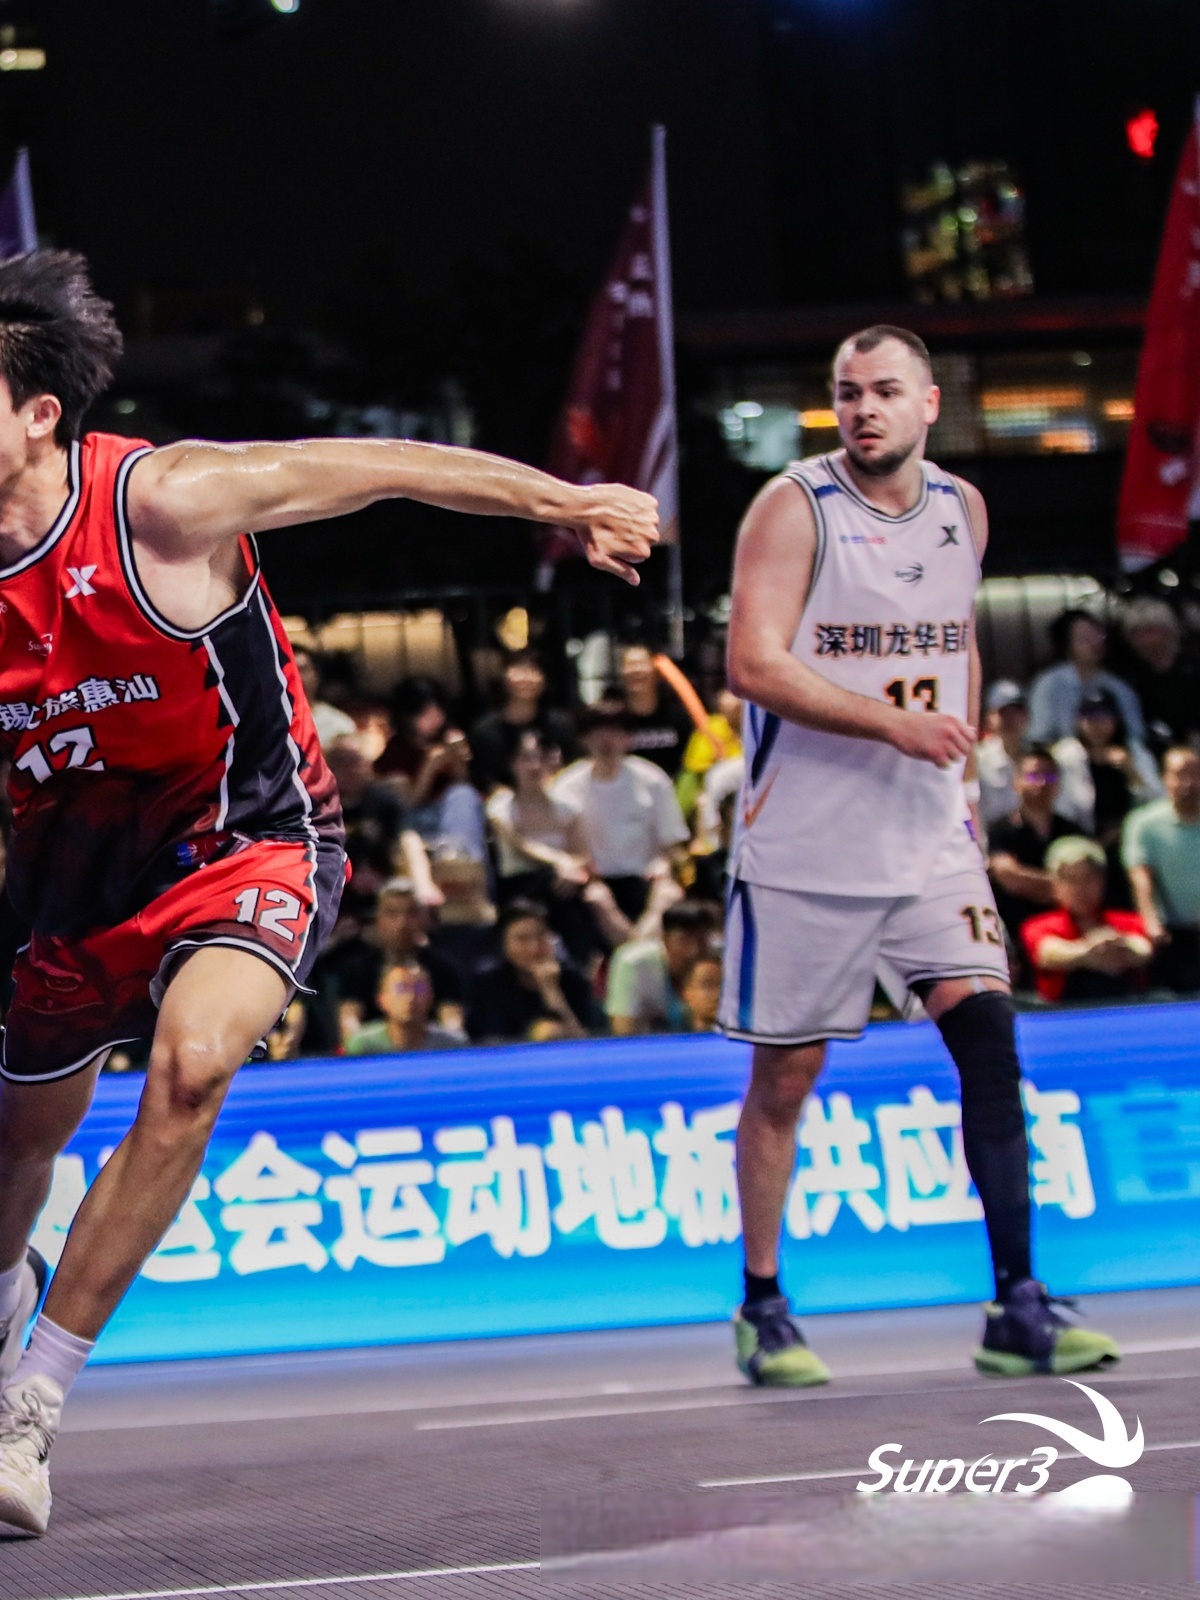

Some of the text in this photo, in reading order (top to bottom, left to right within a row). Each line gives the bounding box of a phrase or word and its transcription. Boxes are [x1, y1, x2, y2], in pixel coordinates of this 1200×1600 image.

[16, 726, 105, 784] 12
[234, 886, 301, 942] 12
[960, 905, 1002, 946] 13
